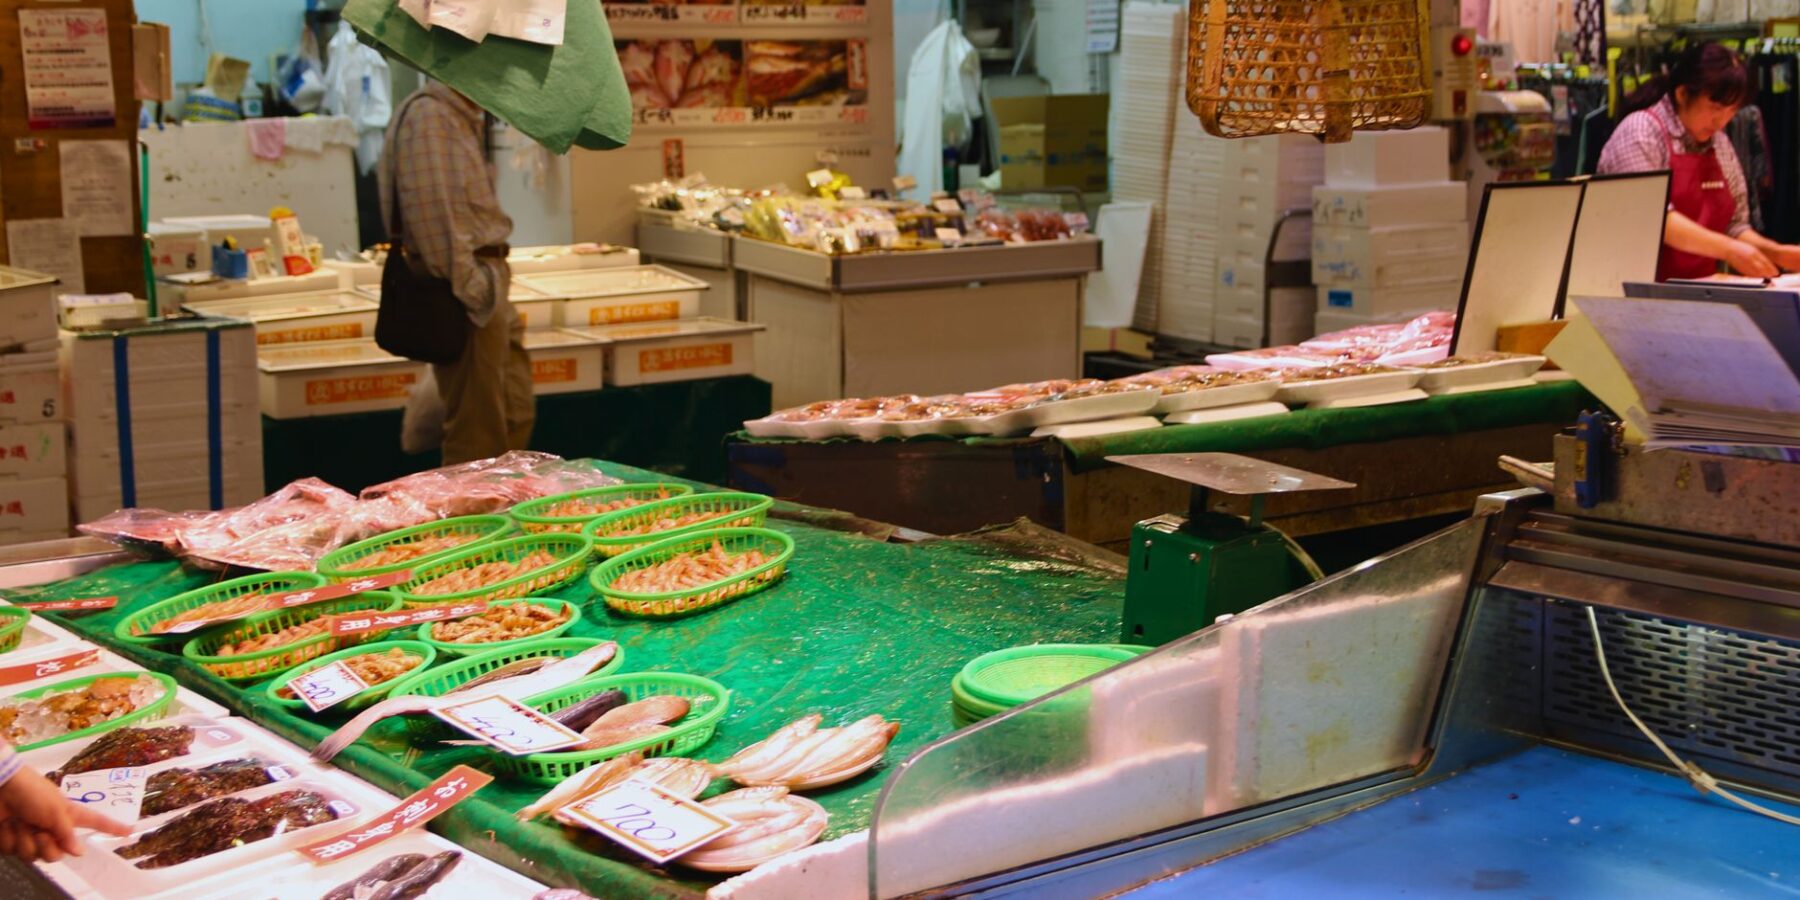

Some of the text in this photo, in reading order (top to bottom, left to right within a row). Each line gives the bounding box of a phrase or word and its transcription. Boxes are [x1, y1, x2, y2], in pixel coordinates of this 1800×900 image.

[339, 603, 479, 631] お刺身用
[311, 777, 468, 858] お刺身用
[601, 803, 676, 841] 700
